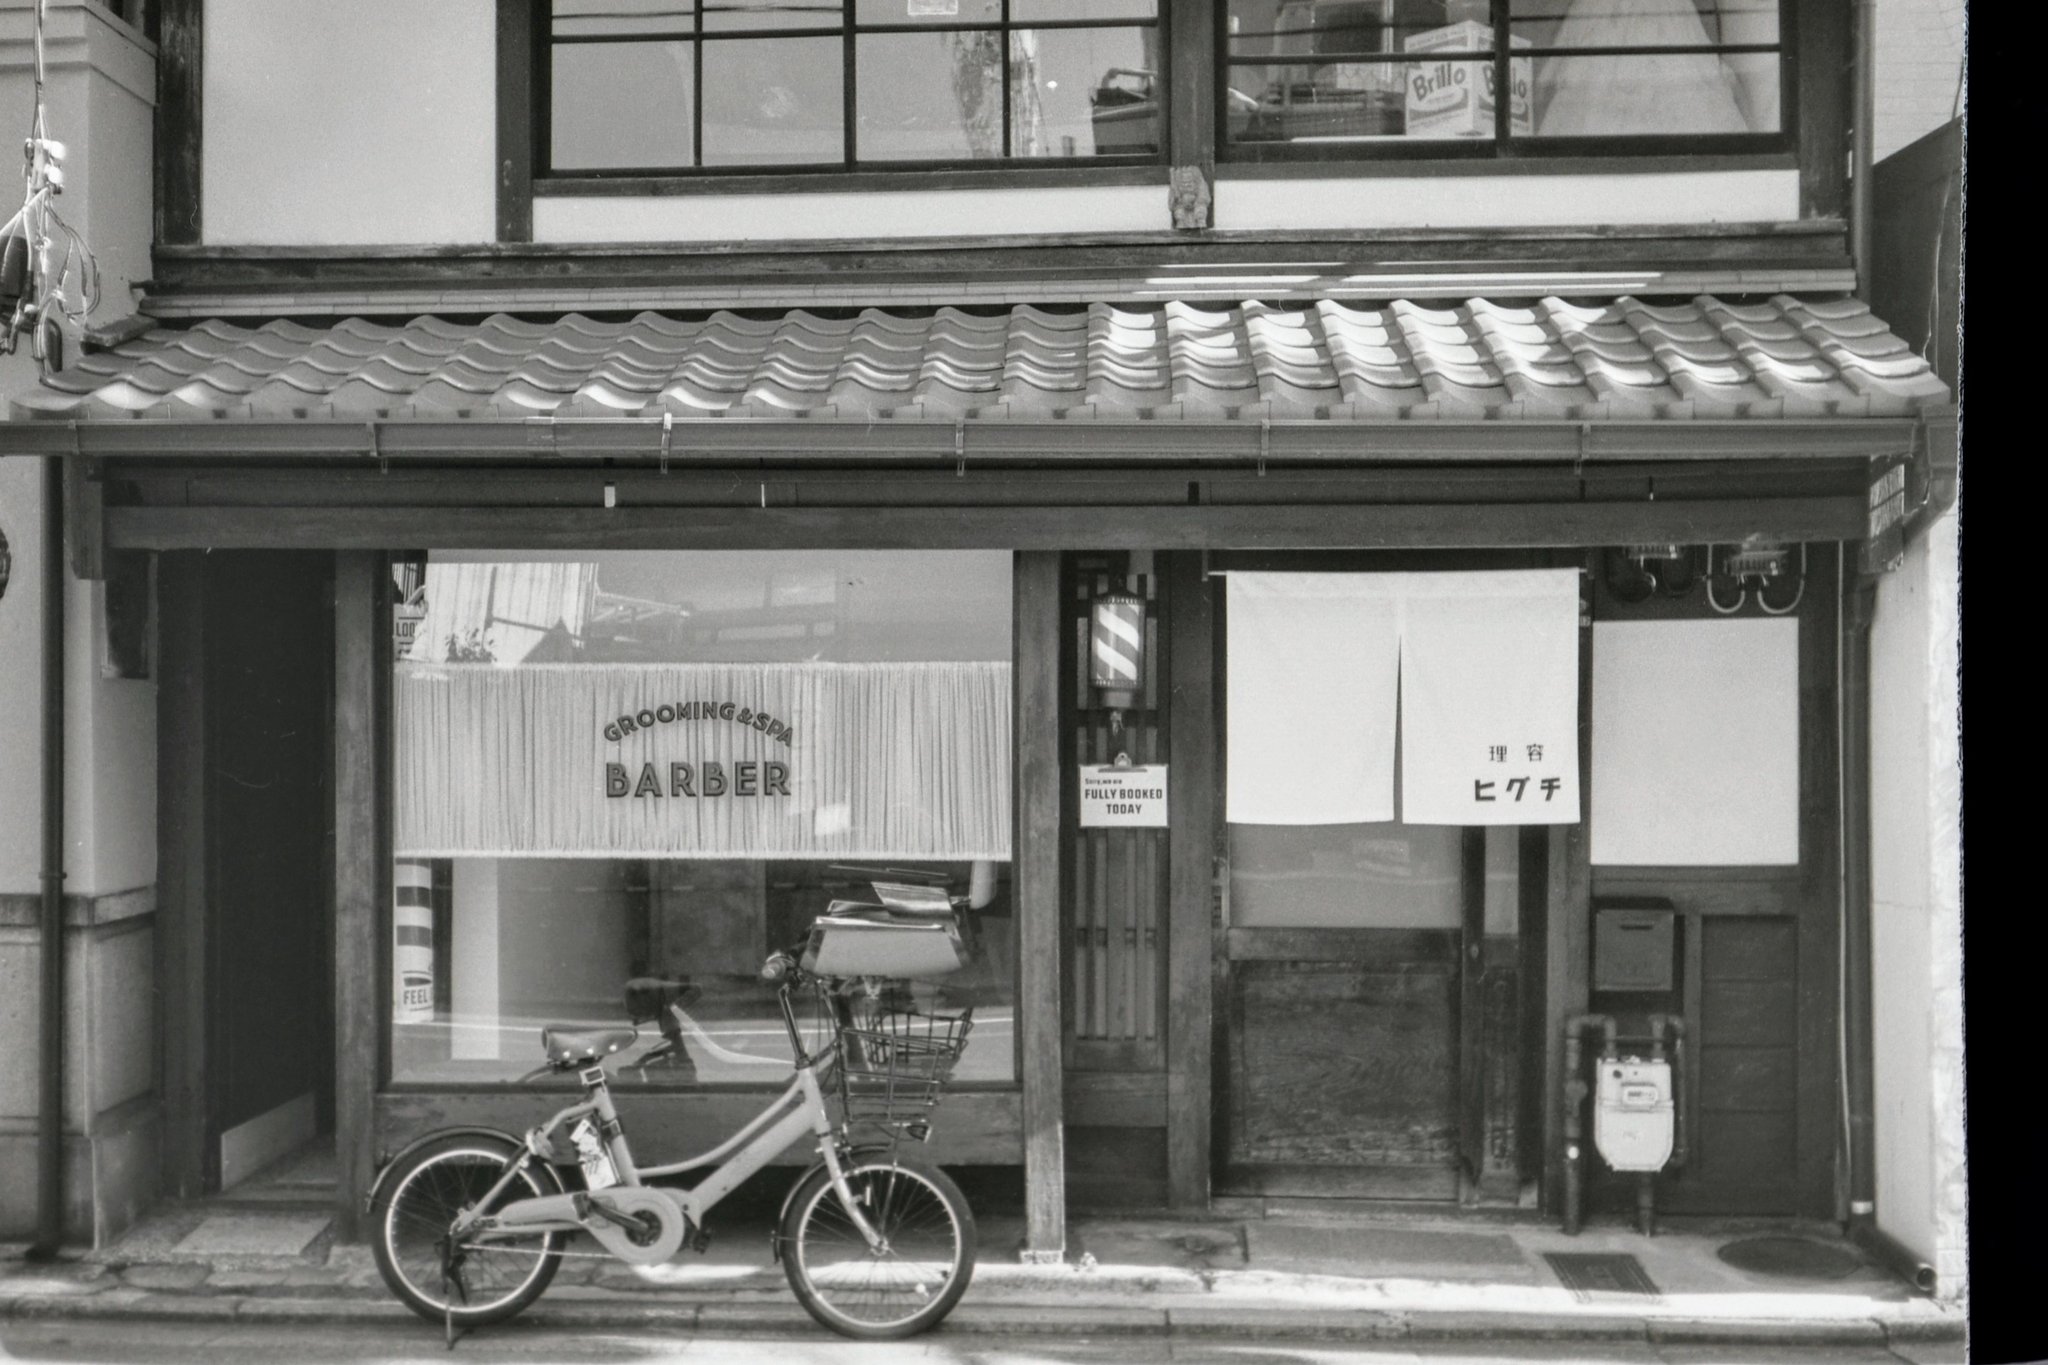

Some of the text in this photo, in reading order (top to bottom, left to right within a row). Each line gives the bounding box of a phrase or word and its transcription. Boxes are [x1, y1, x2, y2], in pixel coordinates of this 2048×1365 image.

[1413, 62, 1466, 101] Brillo
[1489, 743, 1544, 762] 理容
[606, 761, 791, 798] BARBER
[1475, 776, 1561, 802] ヒグチ
[1085, 789, 1163, 799] FULLY BOOKED
[1106, 804, 1142, 814] TODAY
[403, 989, 428, 1005] FEEL
